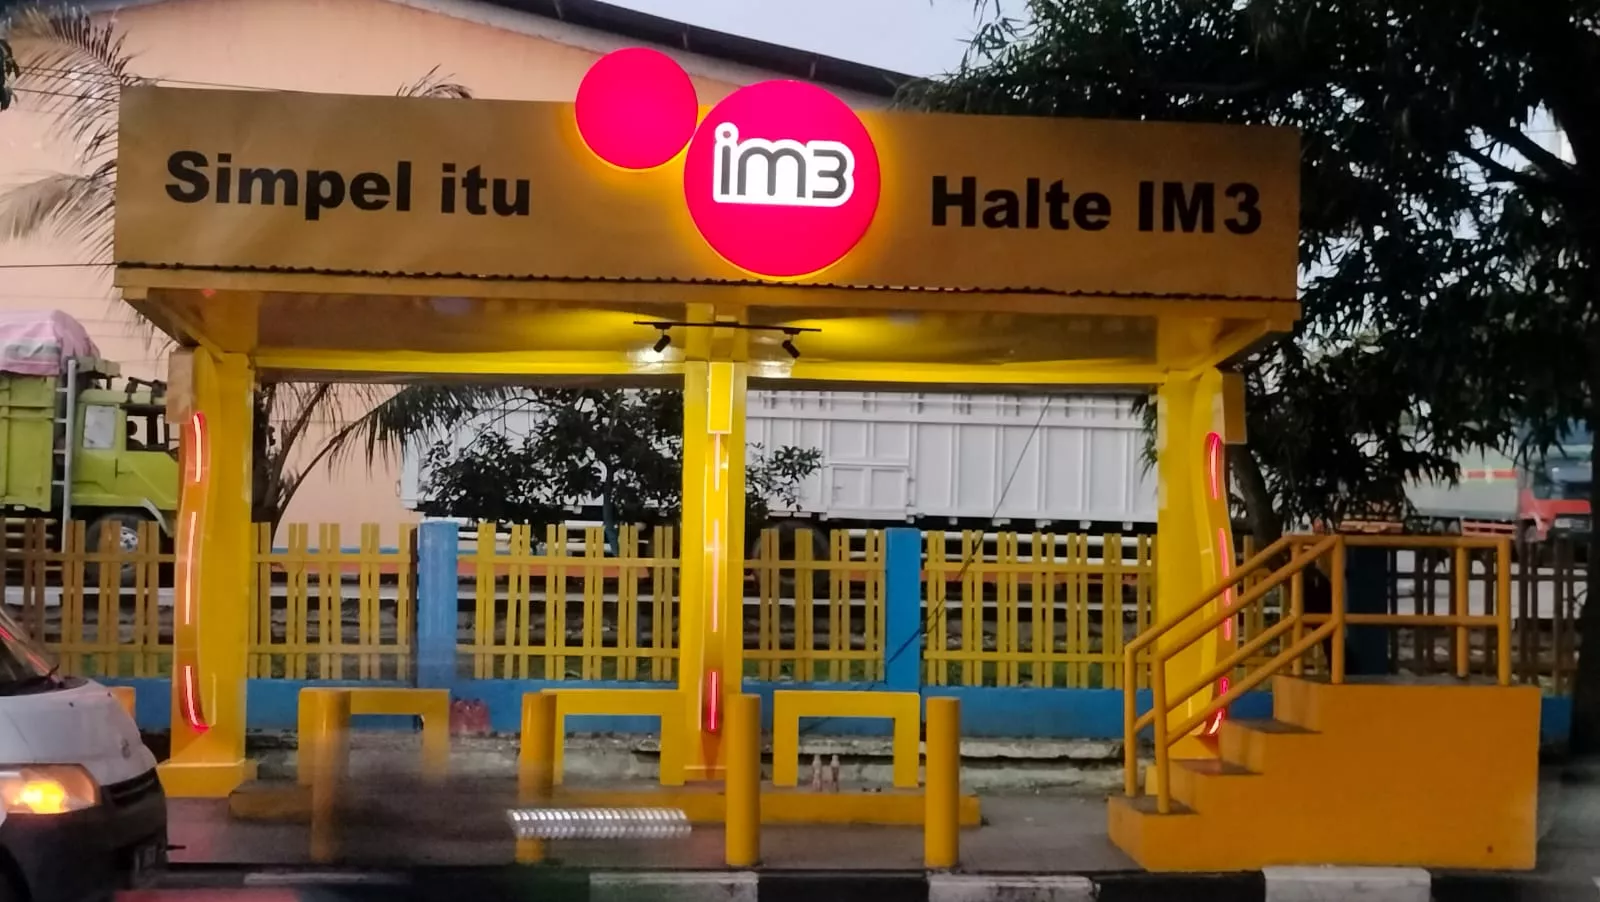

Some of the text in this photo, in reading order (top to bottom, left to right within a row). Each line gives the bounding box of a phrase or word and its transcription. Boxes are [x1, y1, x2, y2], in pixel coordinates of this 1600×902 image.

[164, 150, 531, 221] Simpel itu
[716, 126, 852, 203] im3
[931, 175, 1263, 236] Halte IM3
